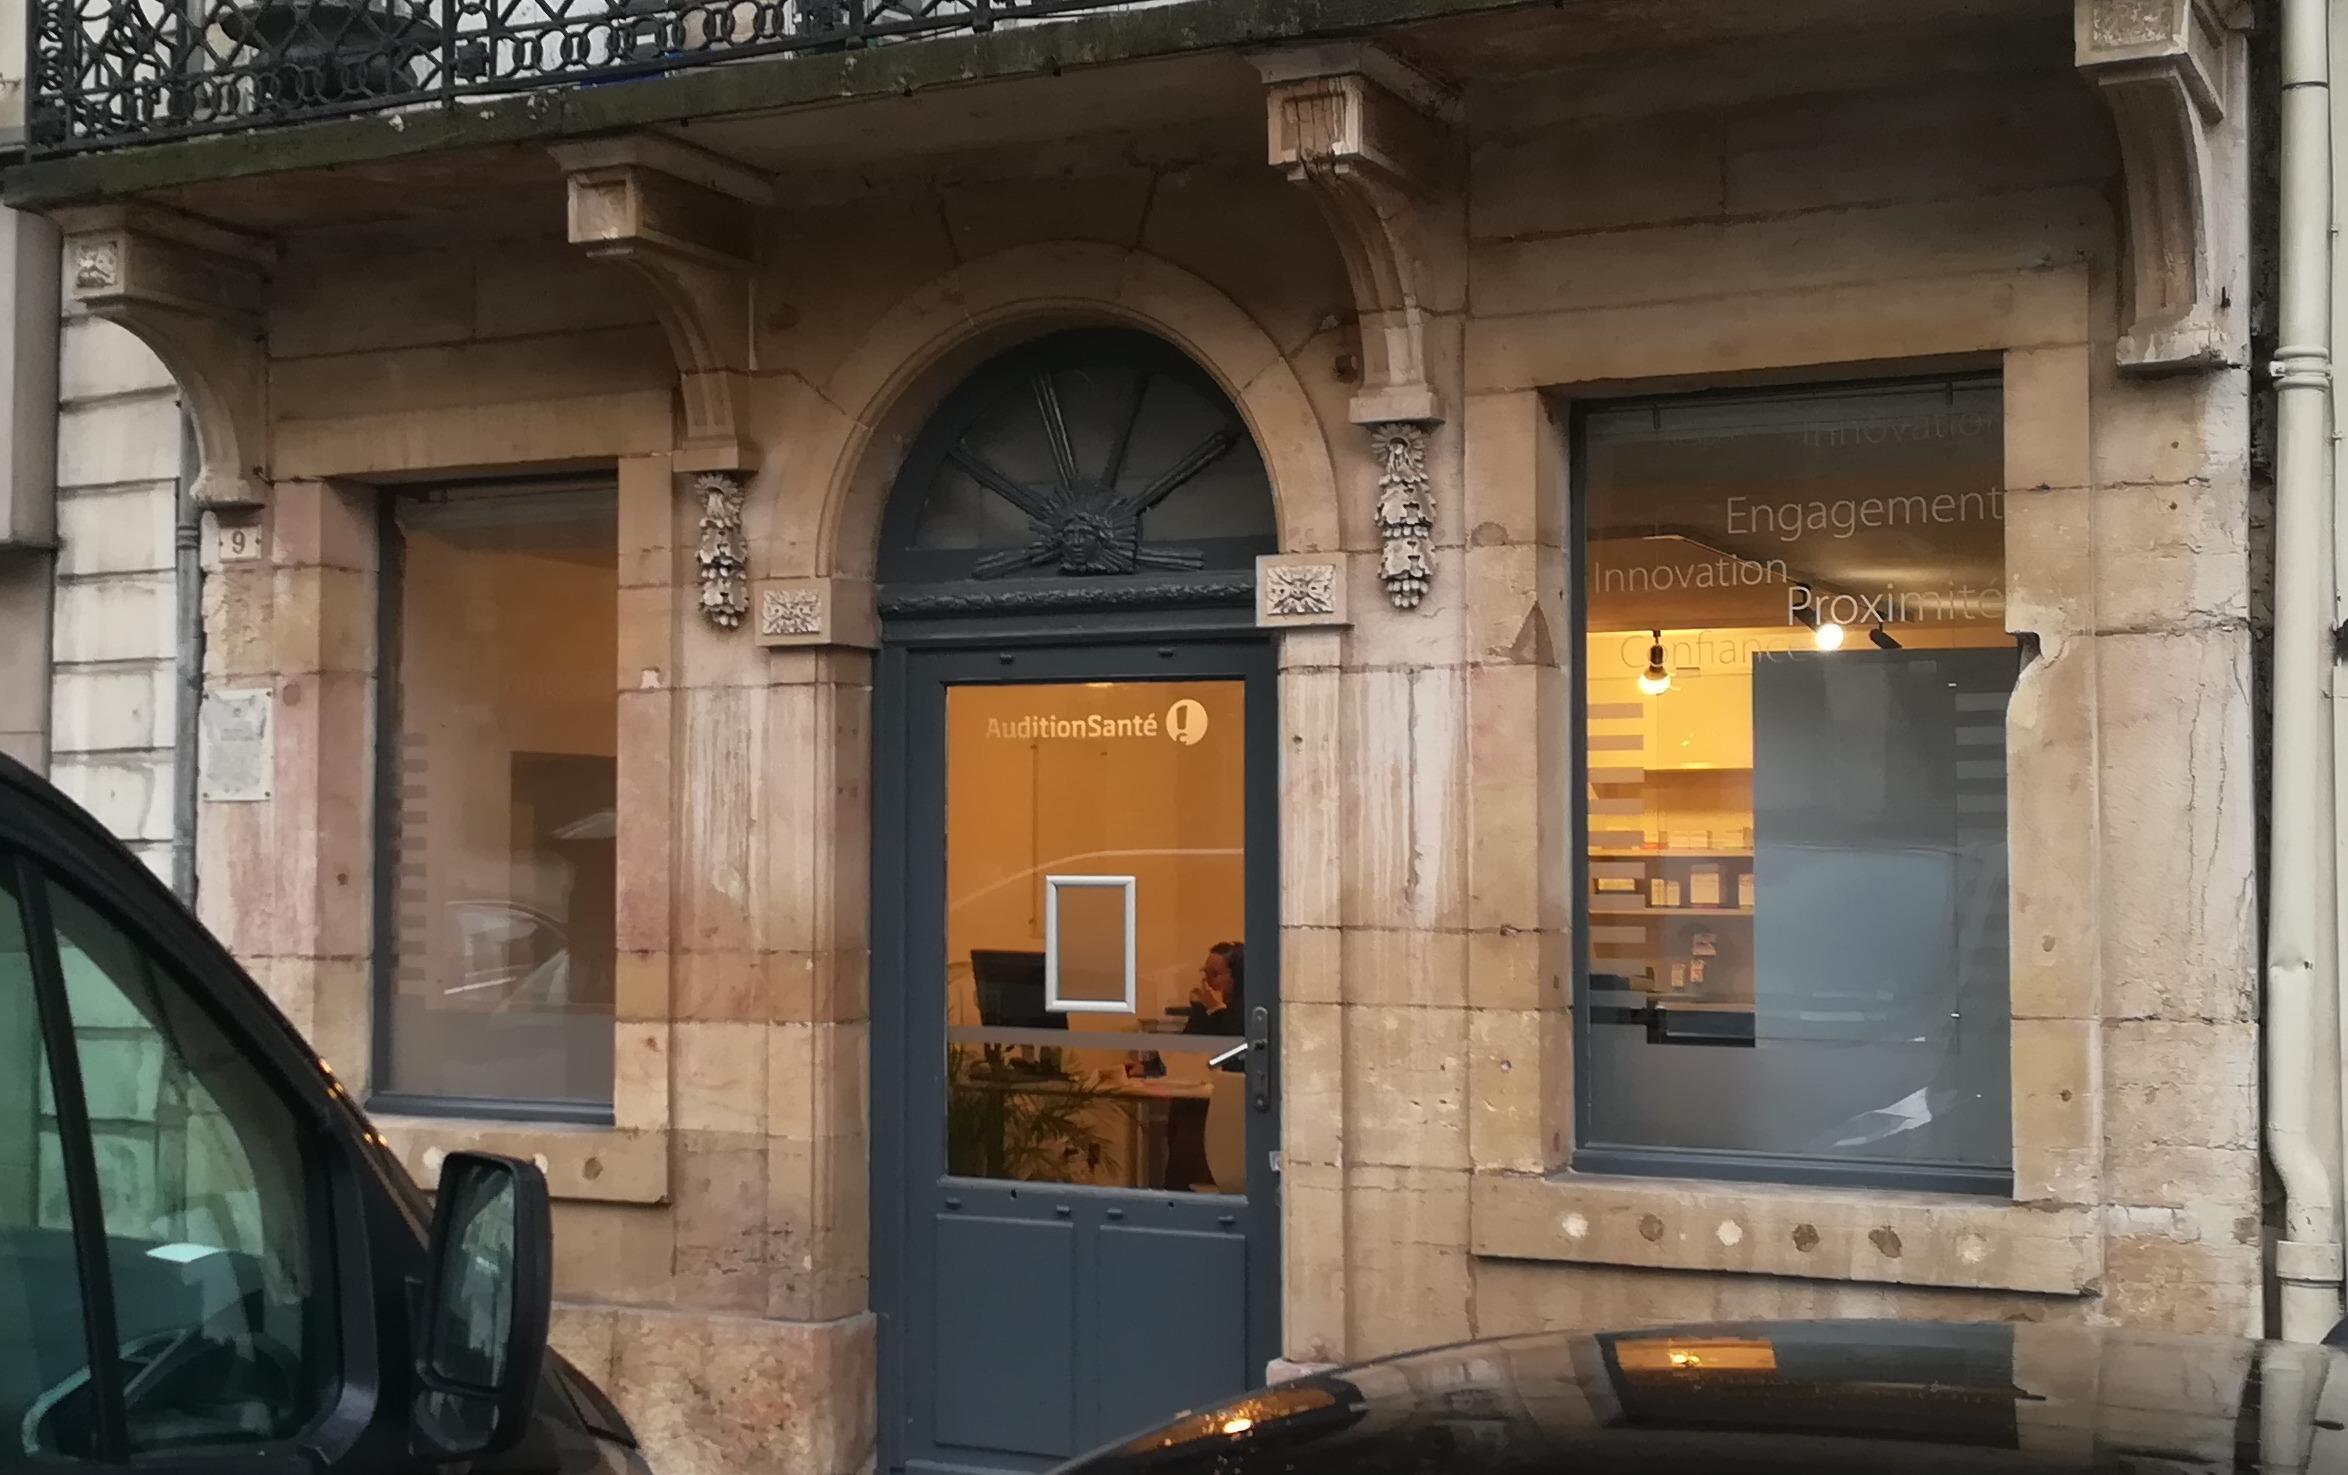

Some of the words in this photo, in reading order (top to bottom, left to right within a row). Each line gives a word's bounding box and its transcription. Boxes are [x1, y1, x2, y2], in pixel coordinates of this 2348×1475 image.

[1726, 487, 2003, 542] Engagement
[232, 531, 246, 554] 9
[1594, 554, 1788, 593] Innovation
[1787, 577, 2004, 626] Proximité
[986, 713, 1158, 739] AuditionSanté
